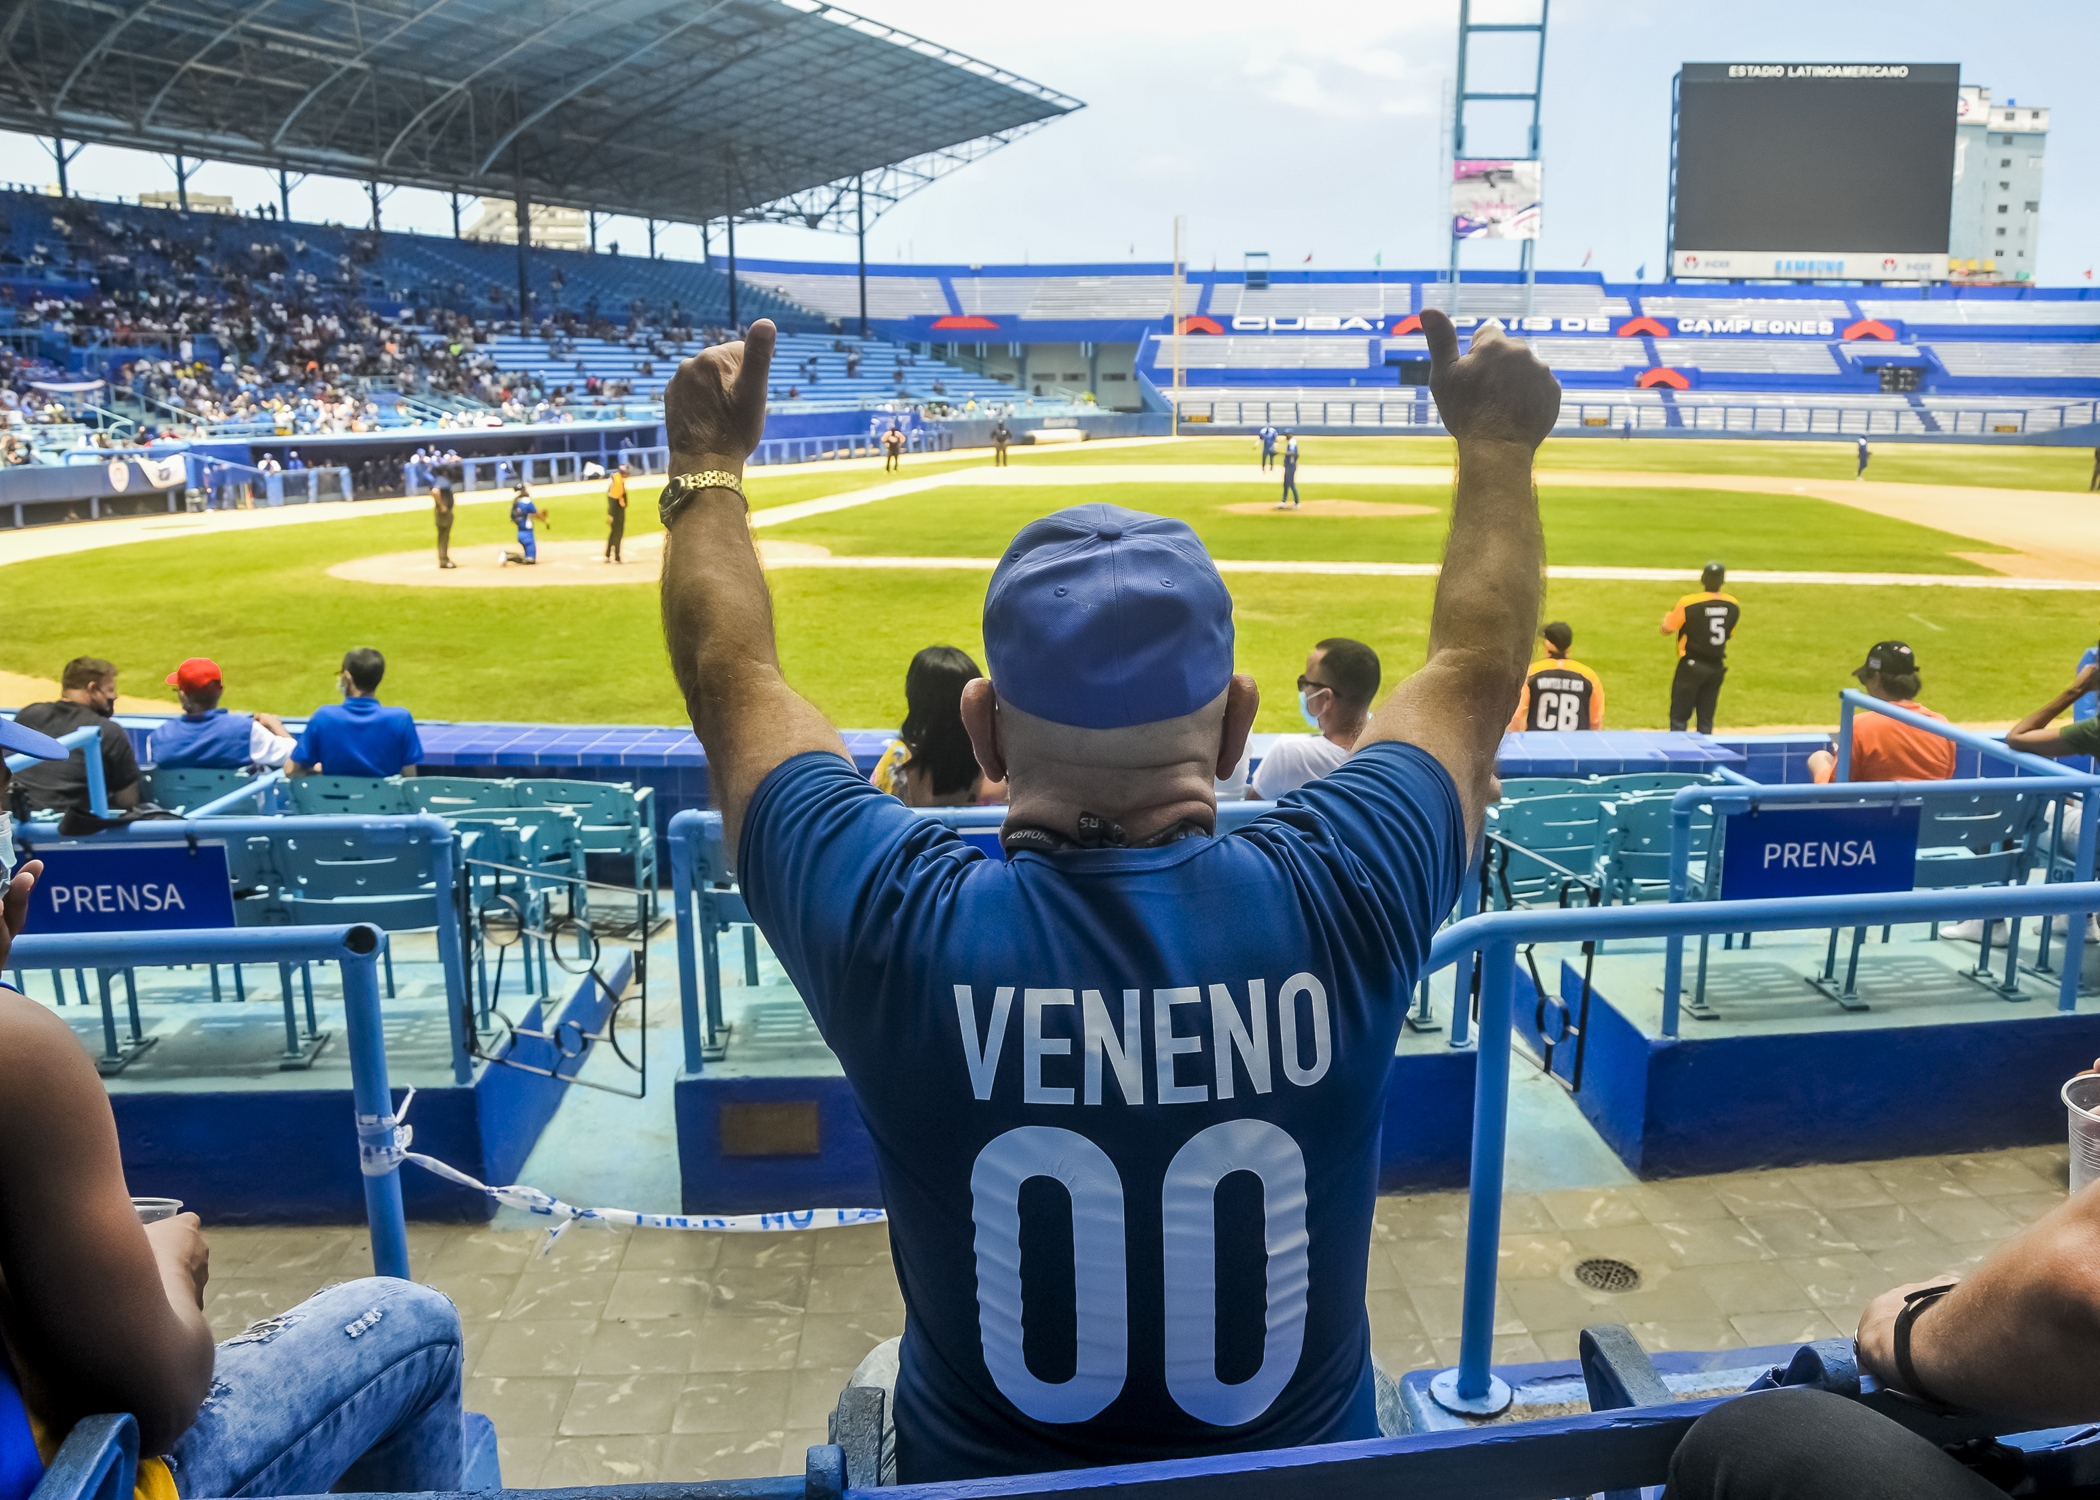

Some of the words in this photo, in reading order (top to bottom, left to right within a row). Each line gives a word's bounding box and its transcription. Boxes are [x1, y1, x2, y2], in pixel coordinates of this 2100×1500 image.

[1728, 65, 1785, 78] ESTADIO
[1787, 65, 1909, 79] LATINOAMERICANO
[1775, 260, 1845, 272] SAMSUNG
[1561, 317, 1610, 332] DE
[1677, 318, 1835, 336] CAMPEONES
[1709, 617, 1726, 646] 5
[1536, 691, 1581, 731] CB
[1764, 841, 1876, 869] PRENSA
[50, 883, 185, 913] PRENSA
[953, 972, 1332, 1106] VENENO
[970, 1118, 1310, 1428] 00
